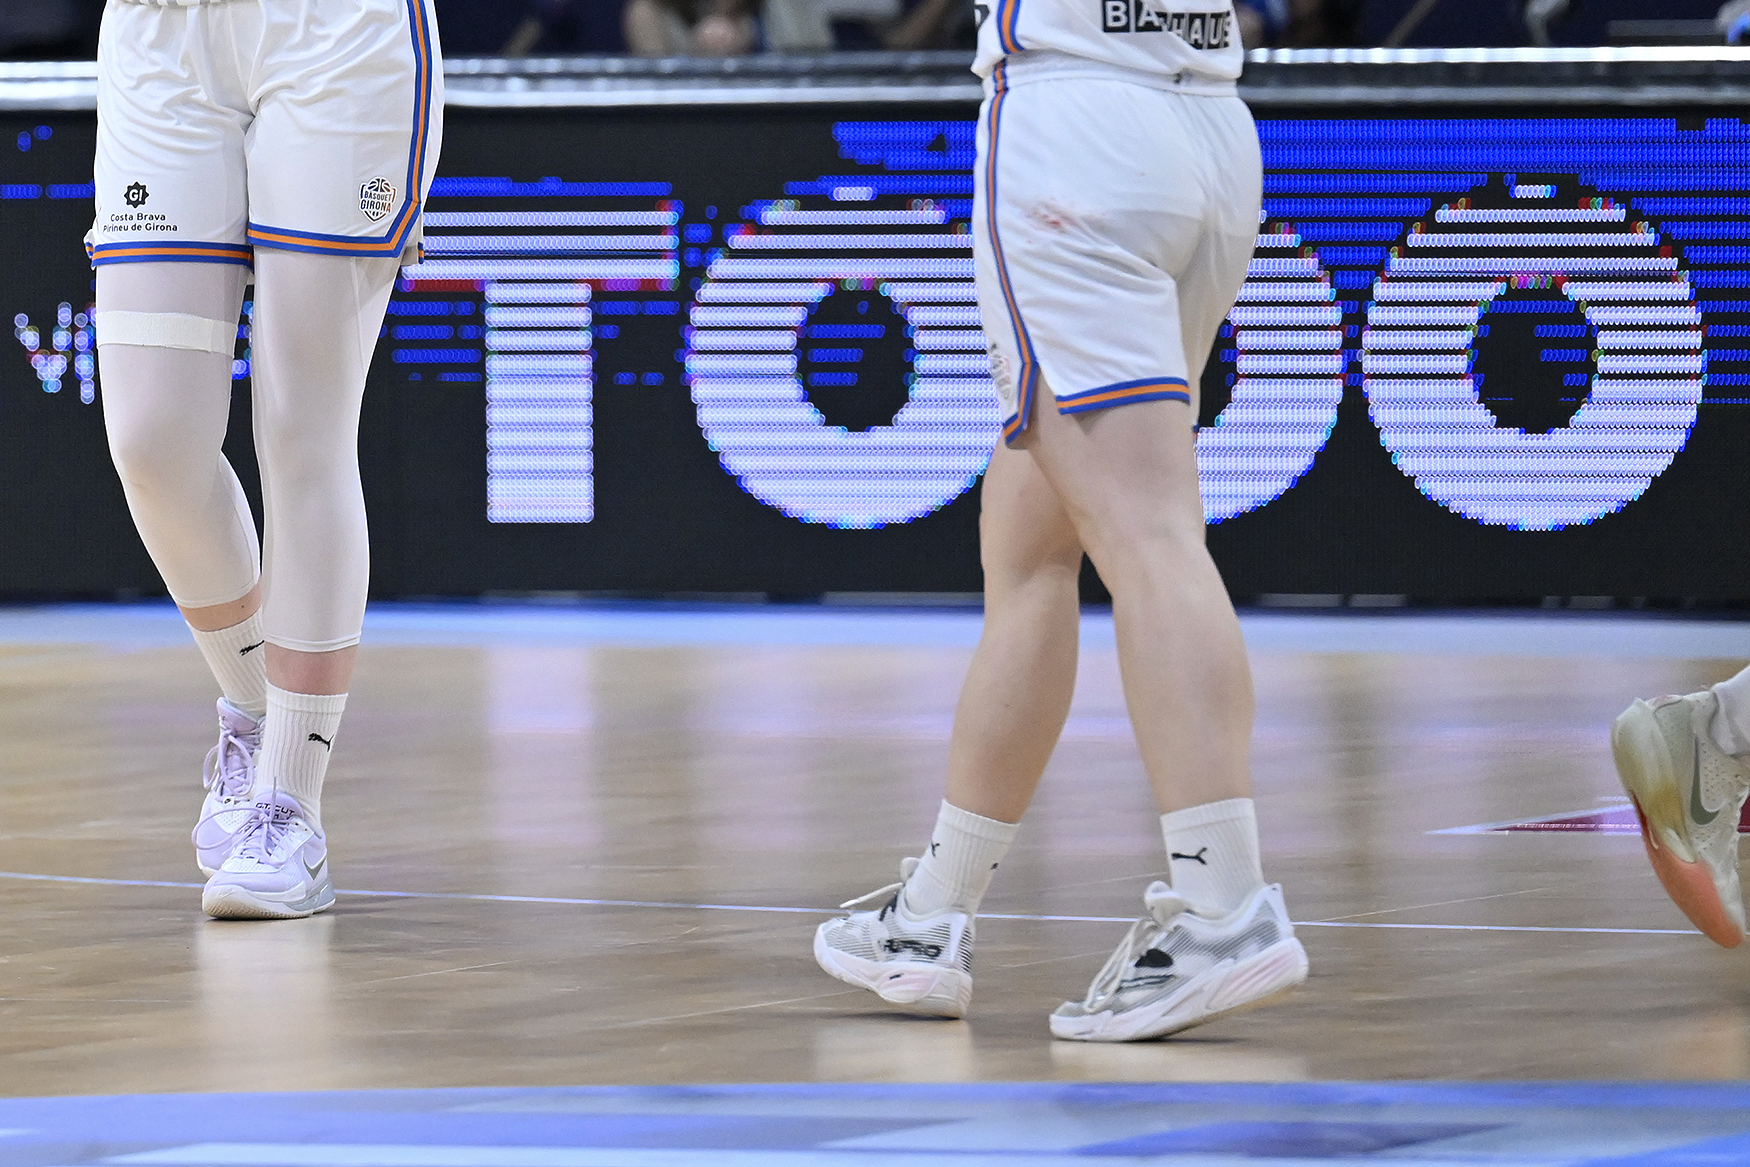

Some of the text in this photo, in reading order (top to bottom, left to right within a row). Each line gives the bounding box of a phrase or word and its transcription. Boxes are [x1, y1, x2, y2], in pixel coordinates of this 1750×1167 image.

[129, 189, 143, 202] GI
[365, 190, 392, 202] BASQUET
[360, 199, 391, 214] GIRONA
[110, 213, 166, 222] Costa Brava
[103, 223, 178, 233] Pirineu de Girona
